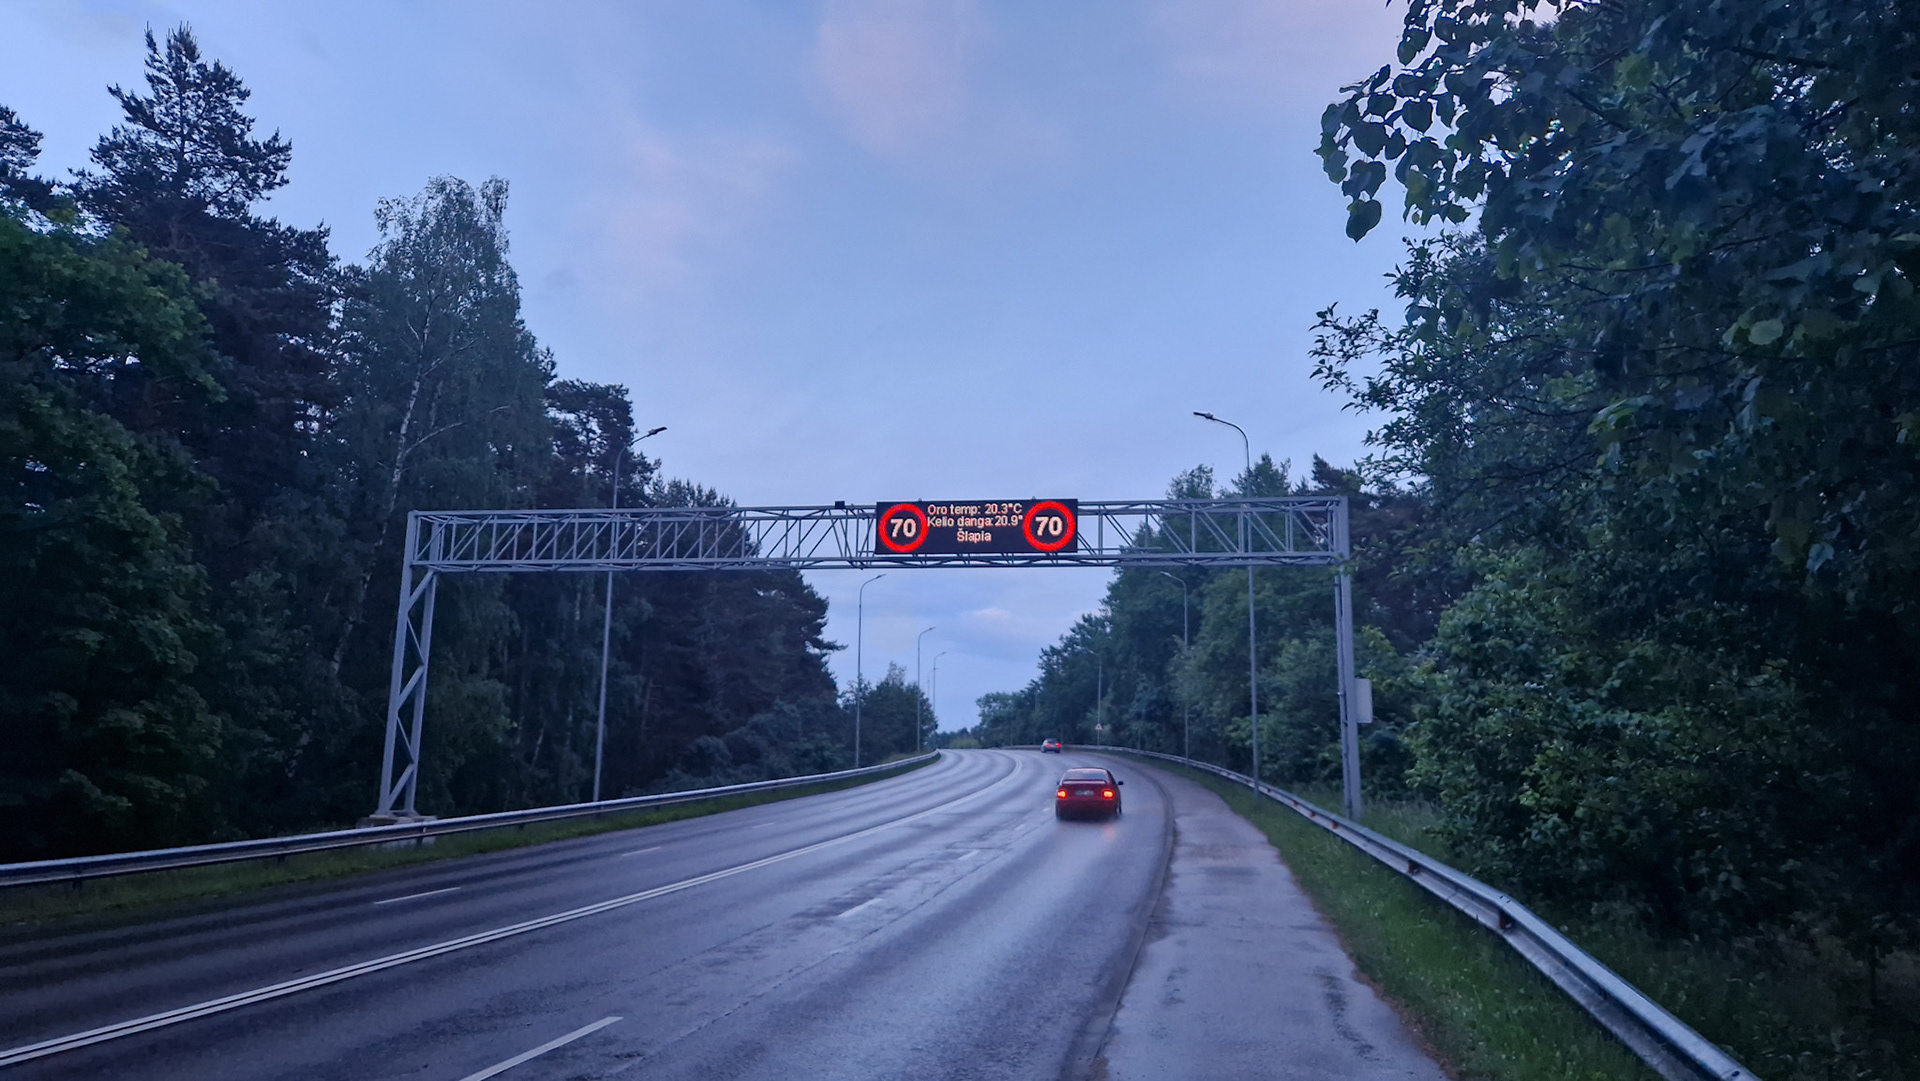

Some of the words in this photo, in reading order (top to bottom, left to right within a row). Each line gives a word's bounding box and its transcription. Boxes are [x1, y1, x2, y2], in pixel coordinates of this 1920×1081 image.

[927, 504, 947, 515] Oro
[950, 503, 981, 516] temp:
[984, 502, 1022, 514] 20.3°C
[890, 518, 917, 538] 70
[927, 516, 954, 527] Kelio
[1035, 516, 1063, 536] 70
[956, 528, 992, 543] Šlapia
